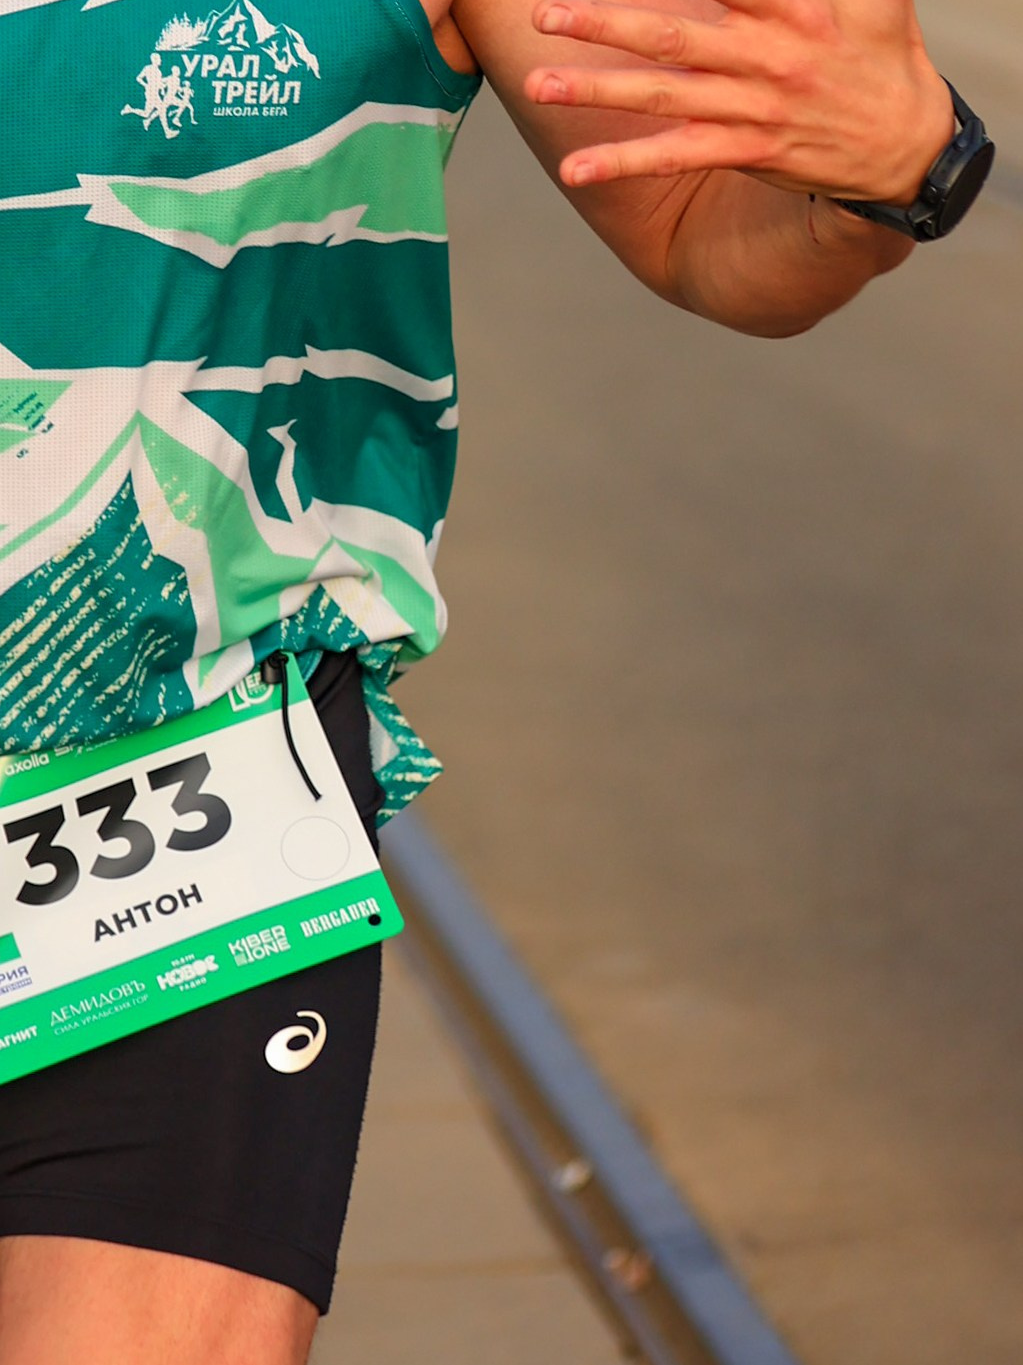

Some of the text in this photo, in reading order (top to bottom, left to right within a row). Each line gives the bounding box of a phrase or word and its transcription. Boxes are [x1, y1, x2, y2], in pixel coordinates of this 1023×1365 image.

[181, 54, 261, 79] УРАЛ
[212, 74, 301, 105] ТРЕЙЛ
[213, 106, 288, 117] ШКОЛА БЕГА
[2, 752, 232, 906] 333
[93, 883, 204, 942] АНТОН
[300, 897, 380, 938] BERGAUER
[50, 980, 146, 1027] ДЕМИДОВЪ
[54, 1022, 80, 1036] СИЛА
[81, 1002, 132, 1026] УРАЛЬСКИХ
